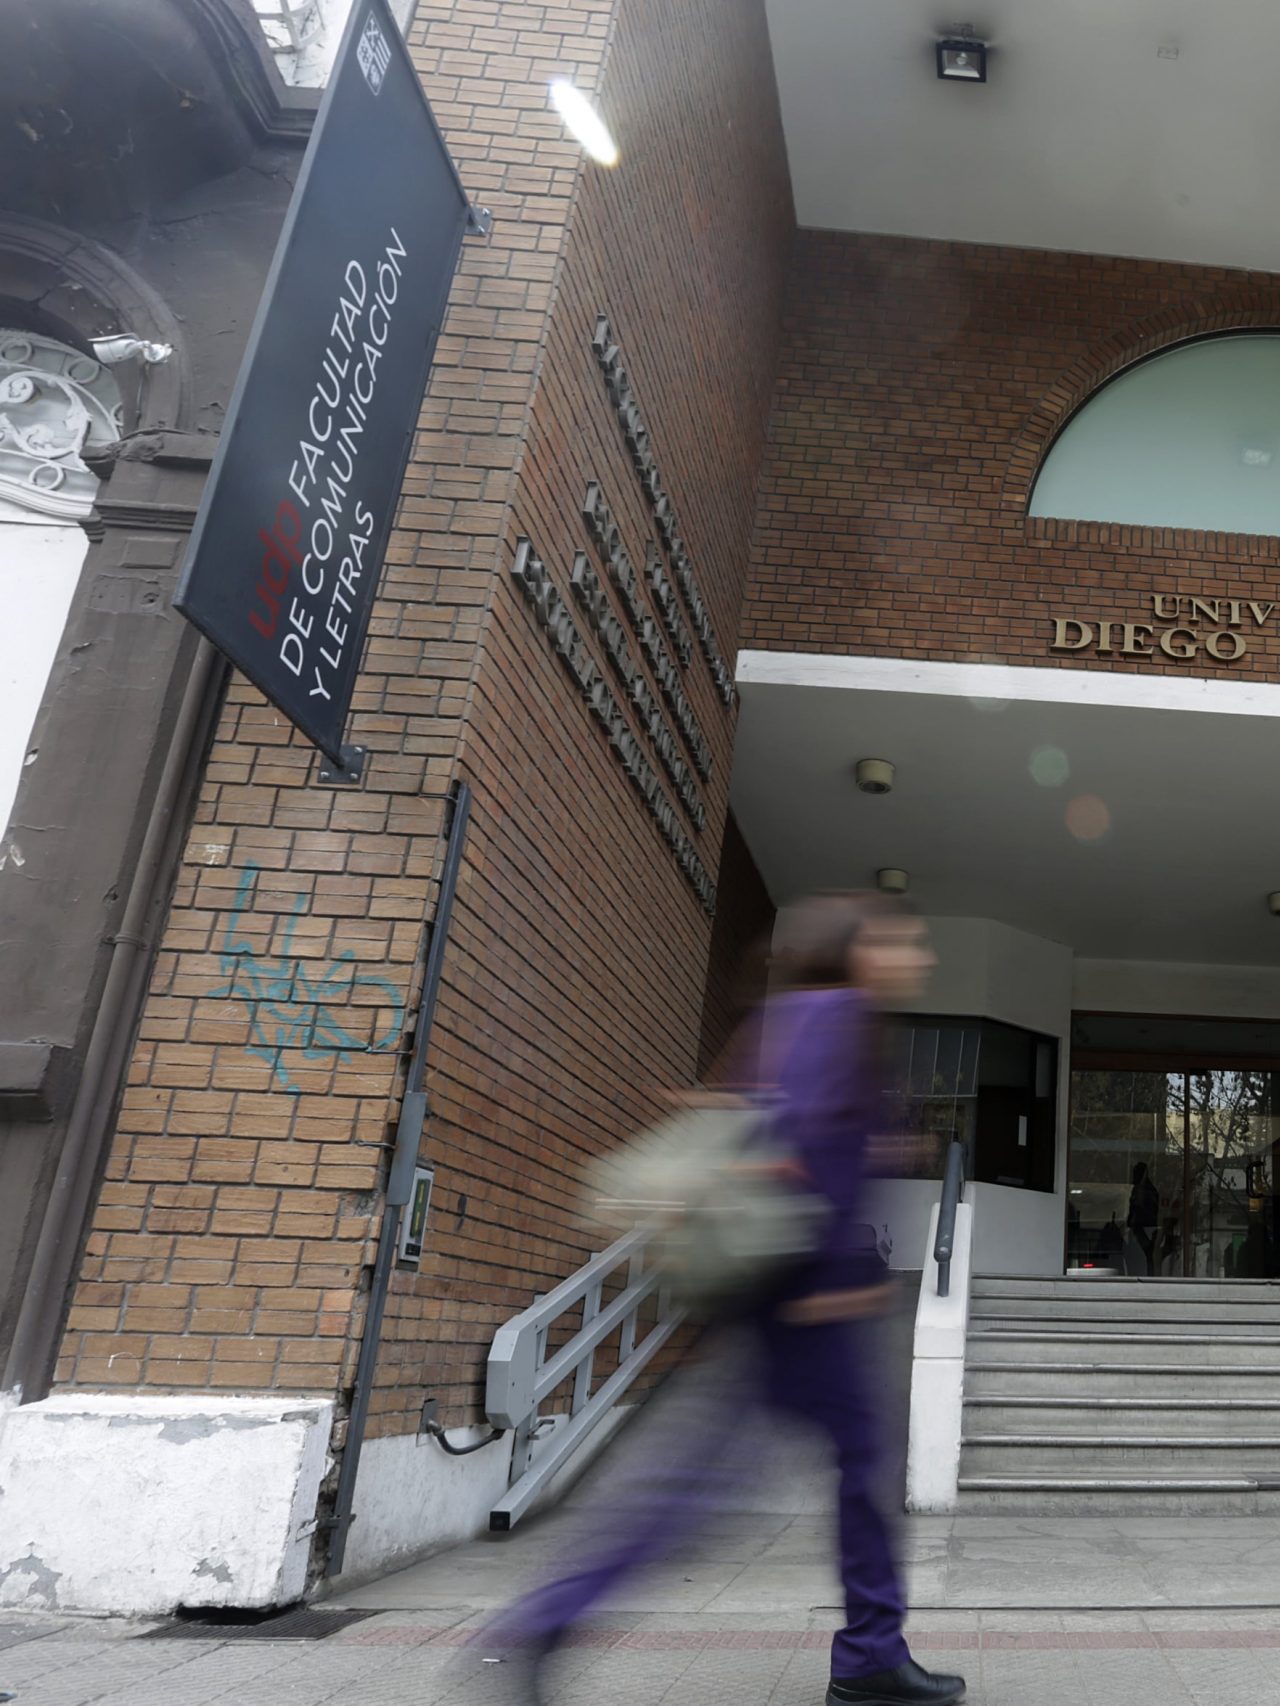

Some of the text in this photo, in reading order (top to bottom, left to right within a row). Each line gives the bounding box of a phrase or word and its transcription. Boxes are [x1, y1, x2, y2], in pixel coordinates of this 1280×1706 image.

[249, 260, 367, 639] udp FACULTAD
[279, 227, 407, 676] DE COMUNICACIÓN
[309, 501, 374, 700] Y LETRAS
[1050, 617, 1247, 661] DIEGO
